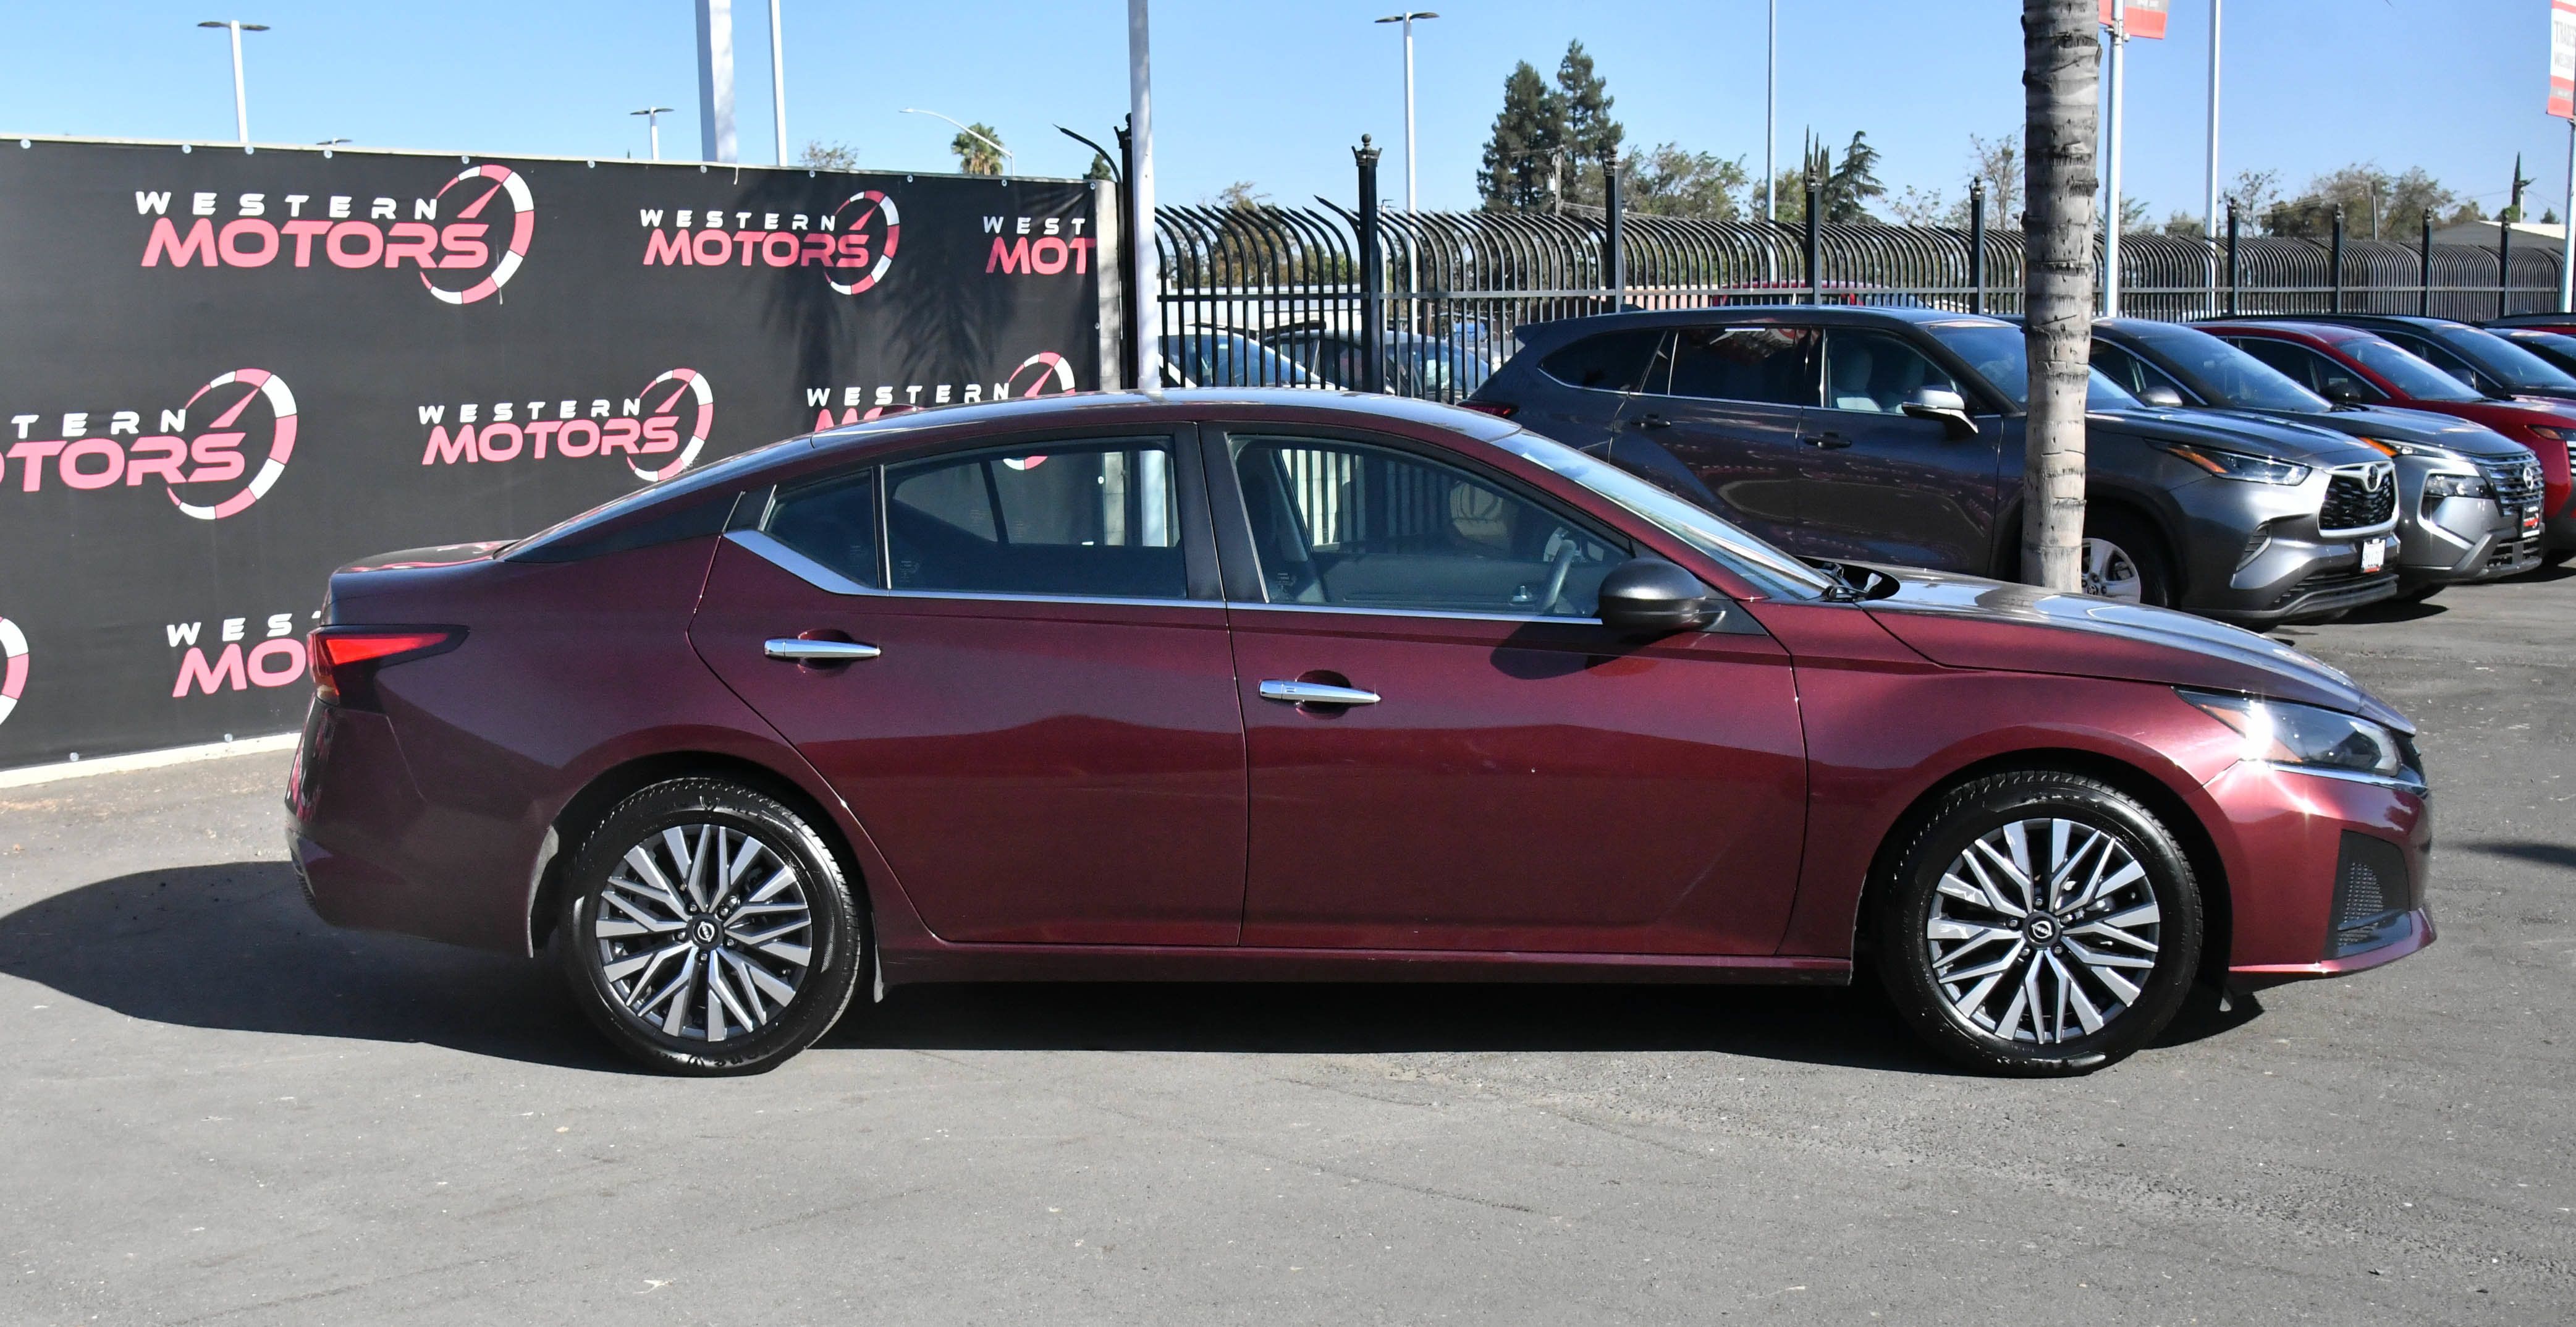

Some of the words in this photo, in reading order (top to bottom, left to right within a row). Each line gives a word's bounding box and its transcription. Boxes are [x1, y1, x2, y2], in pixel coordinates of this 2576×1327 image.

[135, 190, 437, 220] WESTERN
[640, 209, 835, 231] WESTERN
[141, 217, 489, 269] MOTORS
[983, 216, 1086, 235] WEST
[643, 228, 870, 268] MOTORS
[986, 235, 1097, 275] MOT
[806, 382, 1010, 404] WESTERN
[11, 409, 186, 439] TERN
[418, 397, 640, 425] WESTERN
[421, 418, 680, 465] MOTORS
[0, 432, 247, 492] TORS
[172, 638, 306, 698] MO
